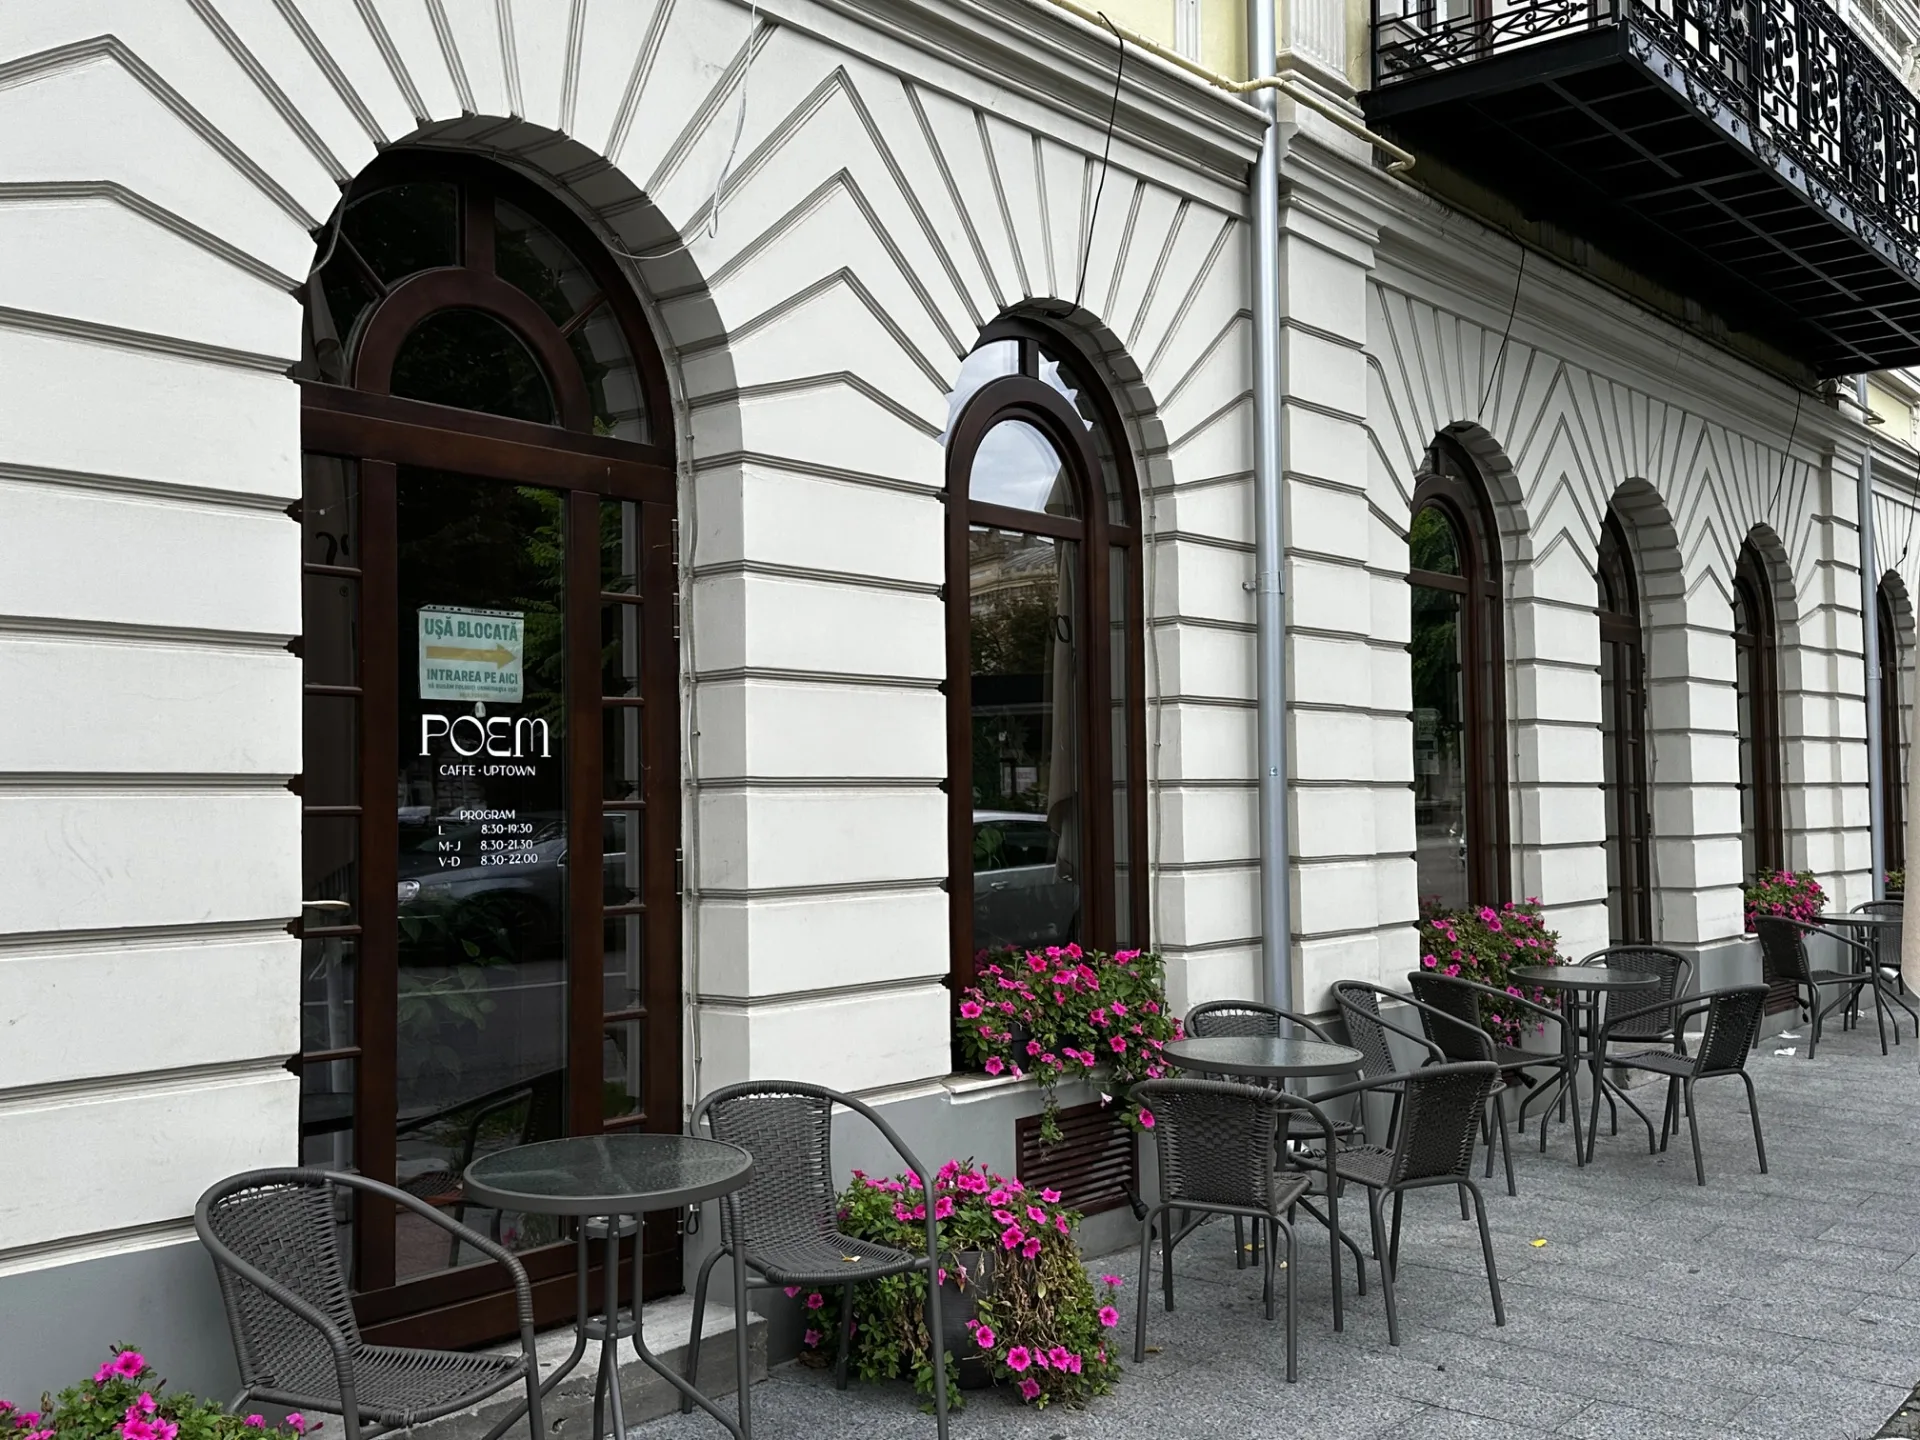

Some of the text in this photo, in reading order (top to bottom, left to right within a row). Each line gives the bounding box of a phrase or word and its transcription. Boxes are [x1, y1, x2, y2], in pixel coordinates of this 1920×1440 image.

[457, 621, 519, 642] BLOCATĂ
[426, 668, 518, 685] INTRAREA PE AICI
[419, 714, 552, 758] POEM
[439, 764, 536, 777] CAFFE UPTOWN
[460, 809, 516, 820] PROGRAM
[438, 825, 446, 836] L
[438, 841, 461, 852] M-J
[438, 853, 538, 867] V-D 8.30-22.00
